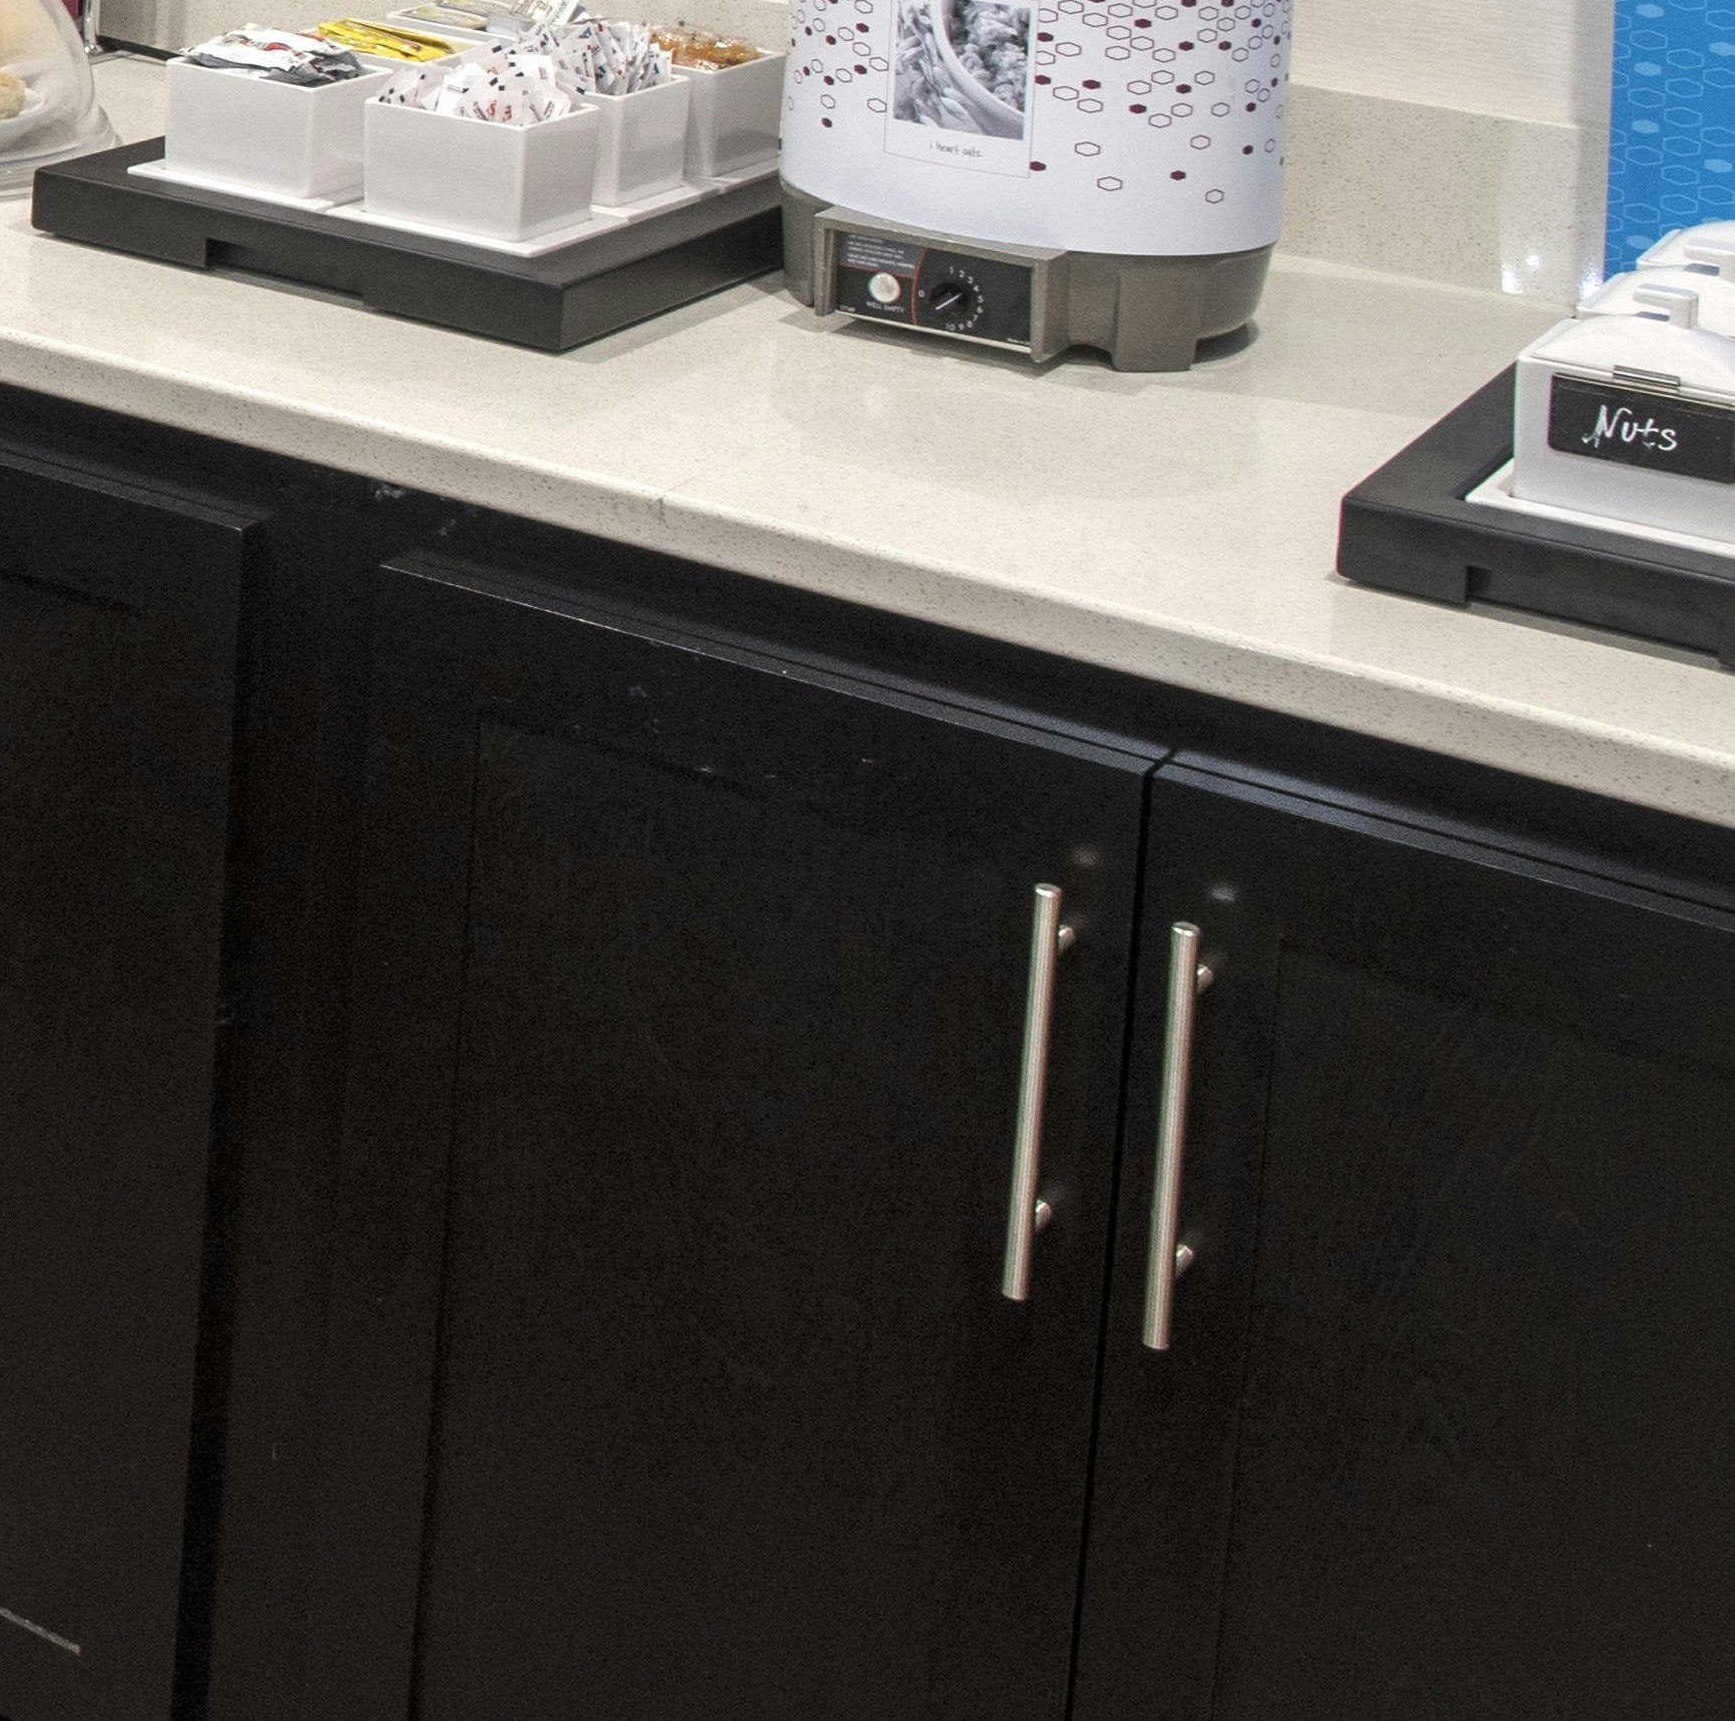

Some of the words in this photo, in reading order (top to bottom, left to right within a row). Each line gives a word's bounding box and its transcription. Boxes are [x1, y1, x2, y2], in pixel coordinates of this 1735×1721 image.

[936, 140, 959, 156] heart
[959, 269, 965, 279] 2
[1581, 404, 1678, 452] Nuts
